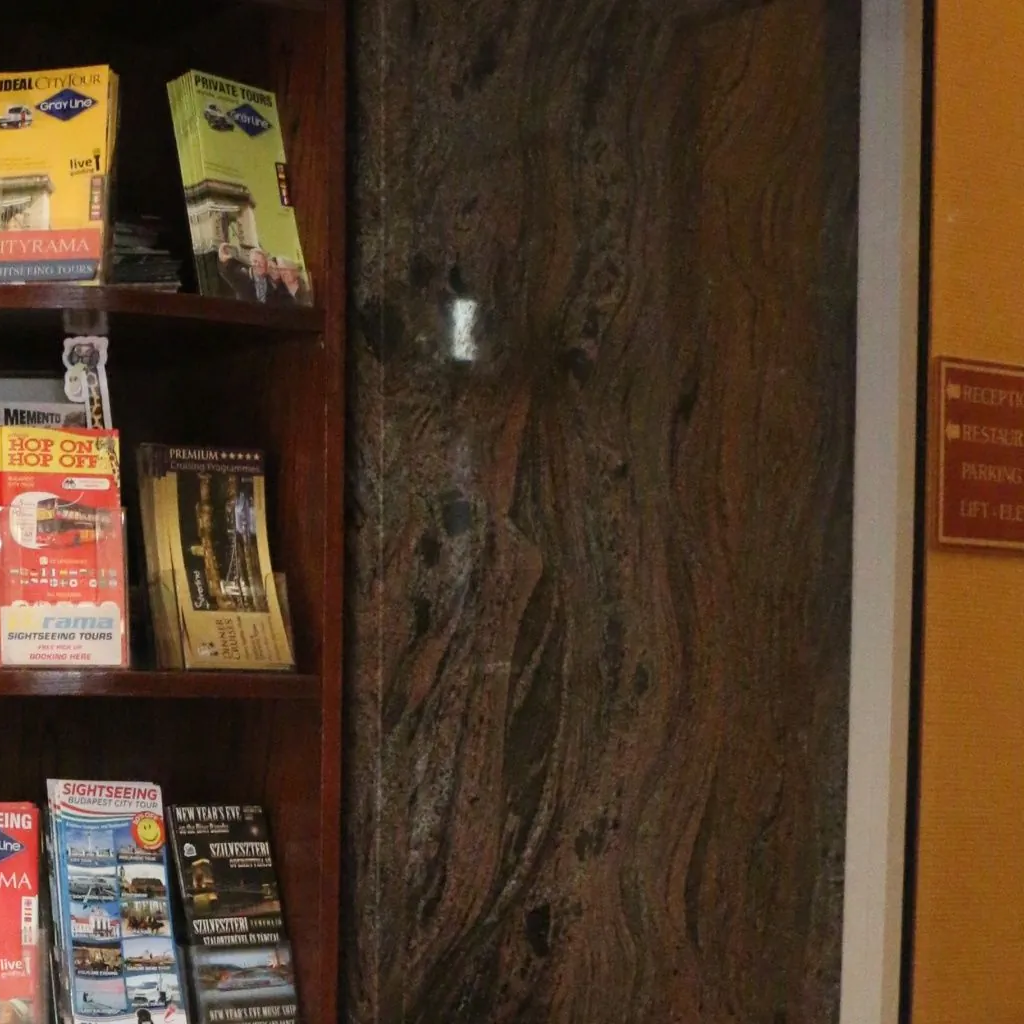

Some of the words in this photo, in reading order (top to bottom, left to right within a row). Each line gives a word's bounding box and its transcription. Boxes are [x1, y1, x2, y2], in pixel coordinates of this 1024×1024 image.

[0, 78, 32, 92] IDEAL
[194, 76, 237, 99] PRIVATE
[240, 88, 273, 108] TOURS
[70, 158, 92, 168] live
[58, 264, 92, 274] TOURS
[4, 408, 60, 425] MEMENTO
[9, 438, 54, 452] HOP
[60, 440, 94, 452] ON
[8, 454, 52, 466] HOP
[59, 455, 98, 468] OFF
[170, 448, 218, 460] PREMIUM
[962, 462, 1022, 484] PARKING
[8, 632, 76, 640] SIGHTSEEING
[80, 632, 112, 640] TOURS
[63, 783, 158, 800] SIGHTSEEING
[68, 797, 112, 806] BUDAPEST
[114, 800, 132, 808] CITY
[136, 801, 158, 809] TOUR
[176, 807, 194, 820] NEW
[196, 806, 224, 820] YEAR'S
[225, 806, 242, 820] EVE
[210, 842, 270, 858] SZILVESZTERI
[193, 917, 248, 934] SZILVESZTERI
[0, 958, 23, 970] live
[210, 1008, 224, 1020] NEW
[248, 1007, 261, 1018] EVE
[262, 1006, 280, 1017] MUSIC
